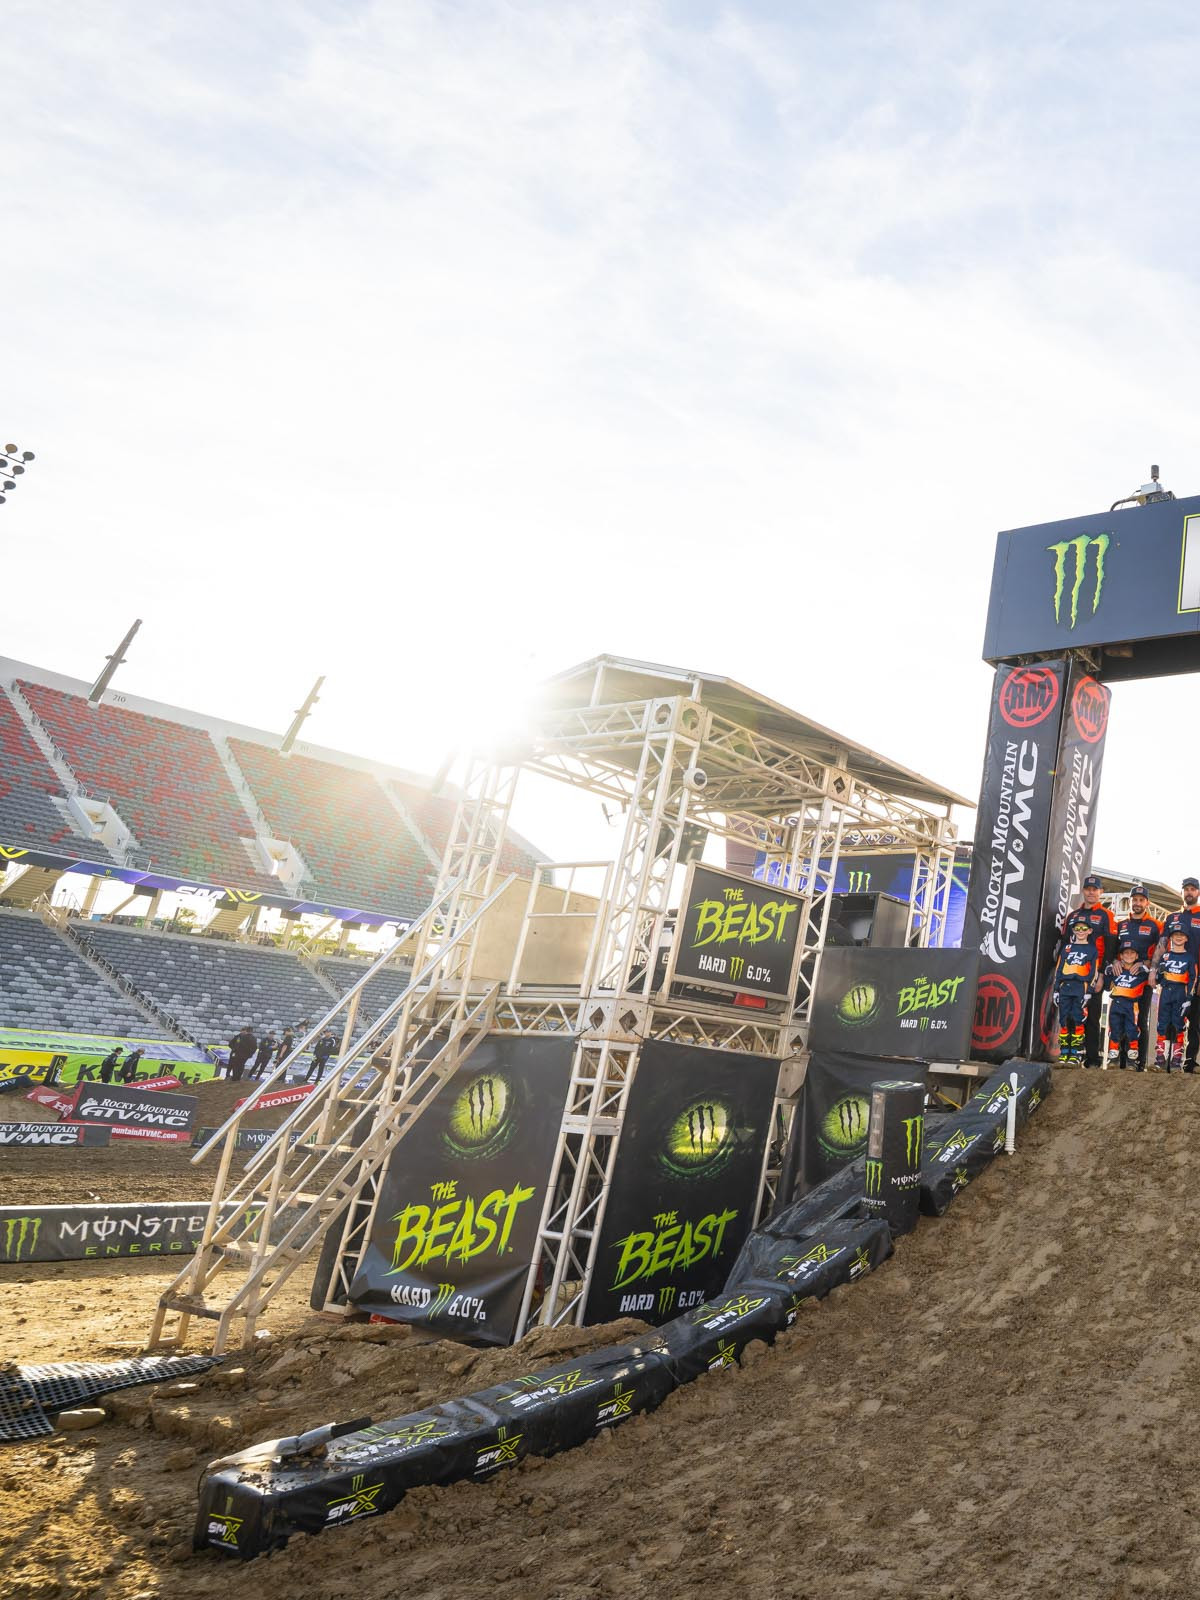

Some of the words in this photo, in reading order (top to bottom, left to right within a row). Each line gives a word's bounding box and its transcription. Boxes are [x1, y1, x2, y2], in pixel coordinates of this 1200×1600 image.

[1007, 682, 1048, 710] RM
[991, 741, 1018, 853] MOUNTAIN
[1062, 748, 1082, 859] MOUNTAIN
[723, 887, 744, 901] THE
[980, 855, 1004, 926] ROCKY
[1055, 863, 1070, 930] ROCKY
[1067, 952, 1087, 960] FLY
[698, 955, 727, 974] HARD
[746, 965, 771, 983] 6.0%
[913, 976, 927, 985] THE
[900, 1019, 918, 1029] HARD
[930, 1020, 948, 1030] 6.0%
[100, 1098, 136, 1110] ROCKY
[136, 1103, 191, 1117] MOUNTAIN
[17, 1124, 79, 1133] MOUNTAIN
[430, 1180, 459, 1201] THE
[652, 1210, 679, 1230] THE
[85, 1240, 204, 1256] ENERGY
[391, 1284, 431, 1311] HARD
[448, 1294, 486, 1321] 6.0%
[619, 1288, 655, 1313] HARD
[677, 1290, 706, 1309] 6.0%
[475, 1439, 520, 1468] SMX
[326, 1488, 381, 1521] SMX
[208, 1520, 241, 1545] SMX
